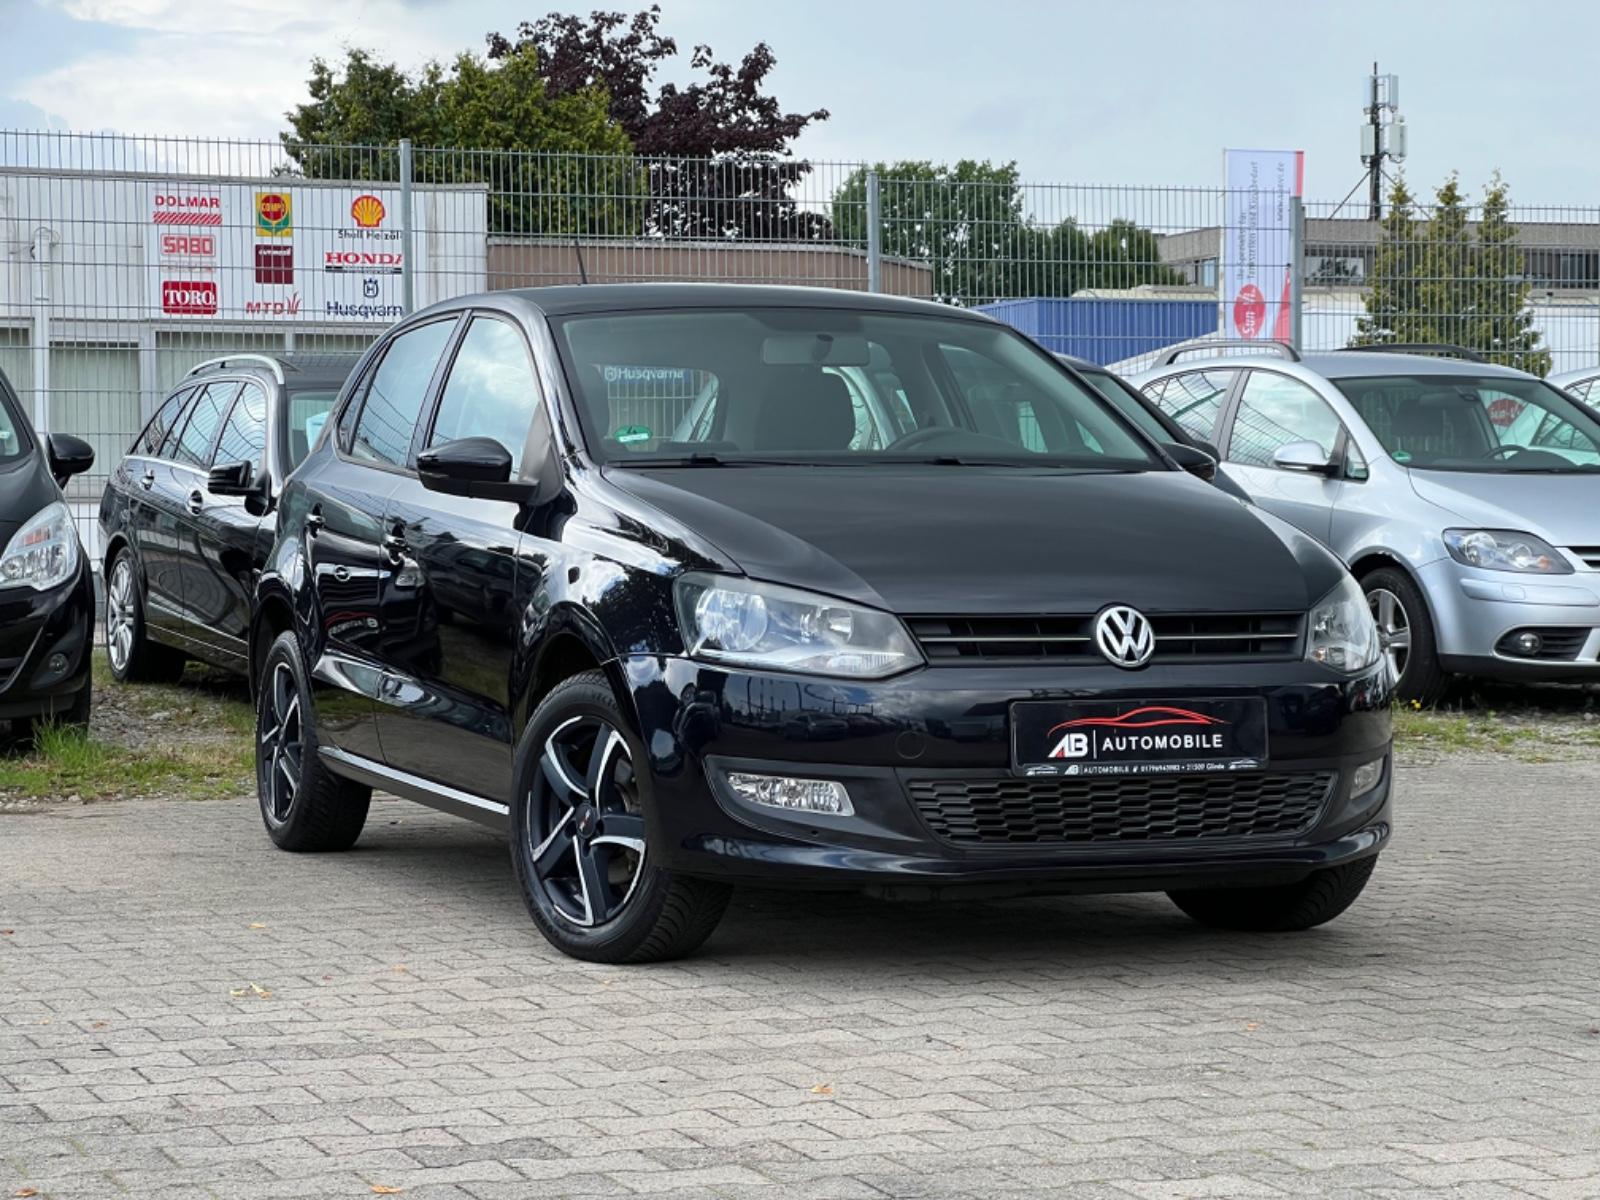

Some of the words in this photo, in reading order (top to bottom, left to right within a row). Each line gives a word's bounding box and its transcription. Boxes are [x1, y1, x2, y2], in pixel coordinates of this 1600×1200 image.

[155, 195, 220, 208] DOLMAR
[338, 229, 362, 239] Shell
[163, 236, 214, 254] SABO
[245, 302, 285, 314] MTD
[326, 301, 402, 319] Husqvarn
[618, 367, 684, 381] Husqvarna
[1048, 733, 1088, 758] AB
[1102, 734, 1223, 752] AUTOMOBILE
